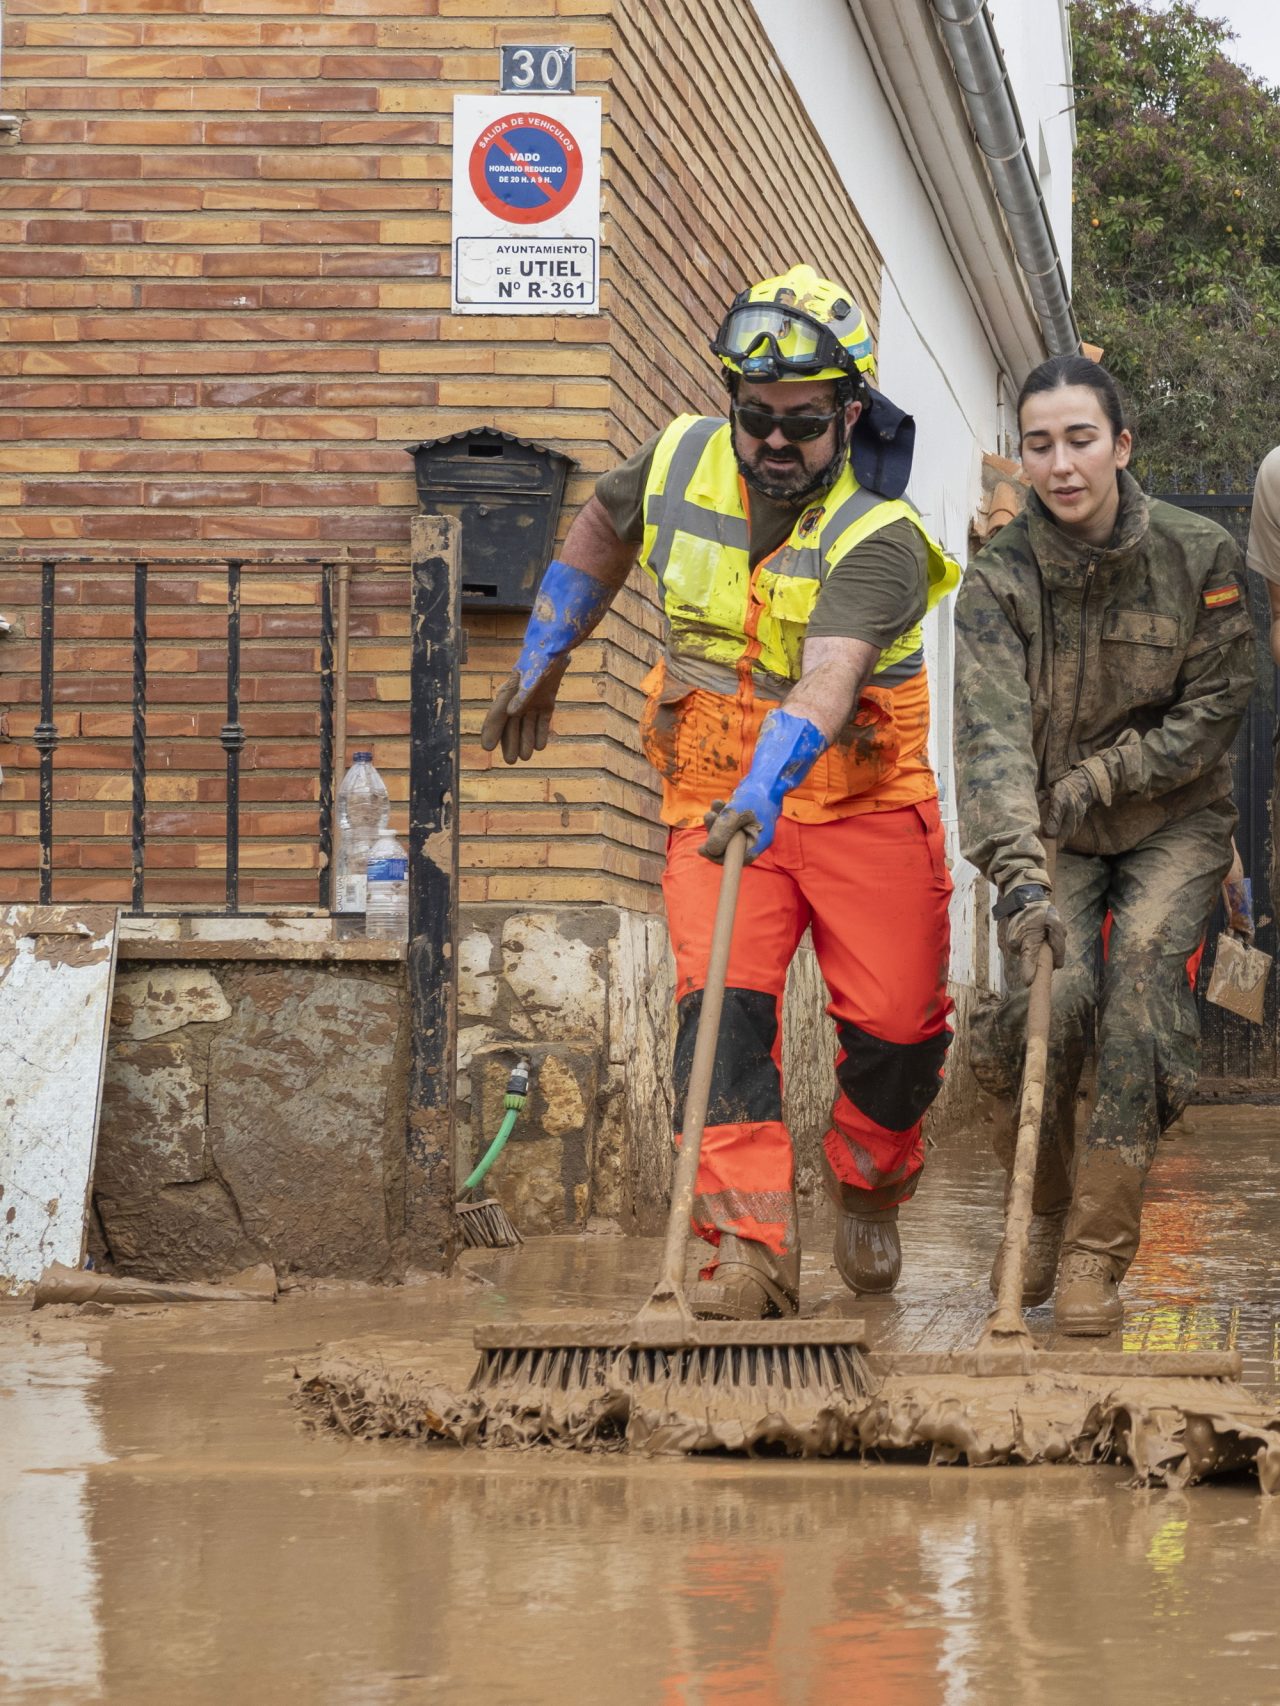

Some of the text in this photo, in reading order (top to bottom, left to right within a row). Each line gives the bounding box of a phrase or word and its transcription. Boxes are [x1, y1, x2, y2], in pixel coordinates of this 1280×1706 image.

[512, 50, 563, 88] 30
[479, 117, 574, 152] SALIDA DE VEHICULOS
[510, 153, 541, 162] VADO
[489, 165, 563, 174] HORARIO REDUCIDO
[510, 176, 520, 184] 20
[521, 176, 529, 184] H.
[530, 176, 536, 184] A
[496, 246, 588, 254] AYUNTAMIENTO
[496, 261, 582, 277] DE UTIEL
[498, 282, 585, 298] Nº R-361
